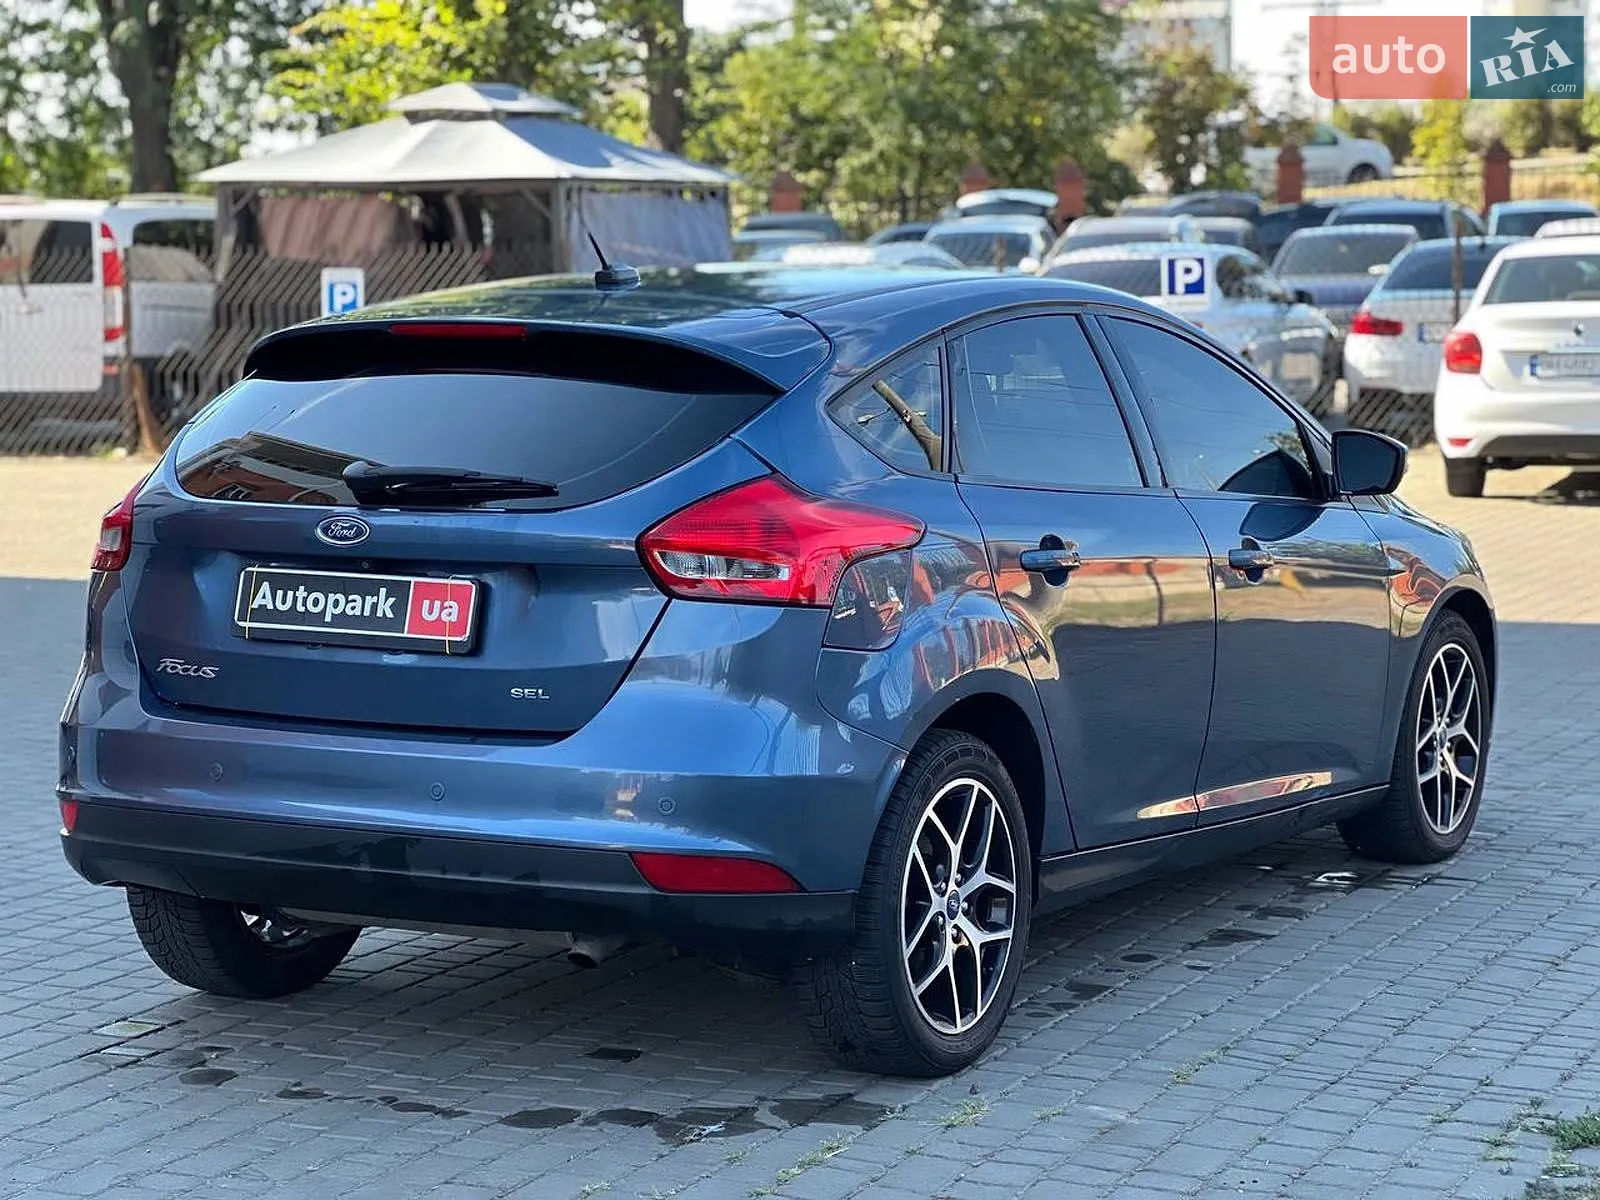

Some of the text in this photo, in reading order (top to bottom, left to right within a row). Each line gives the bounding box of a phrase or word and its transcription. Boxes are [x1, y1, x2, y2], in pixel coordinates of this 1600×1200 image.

[1174, 258, 1203, 294] P
[333, 283, 356, 313] P
[327, 522, 358, 538] Ford
[251, 581, 460, 621] Autopark ua
[510, 687, 550, 700] SEL
